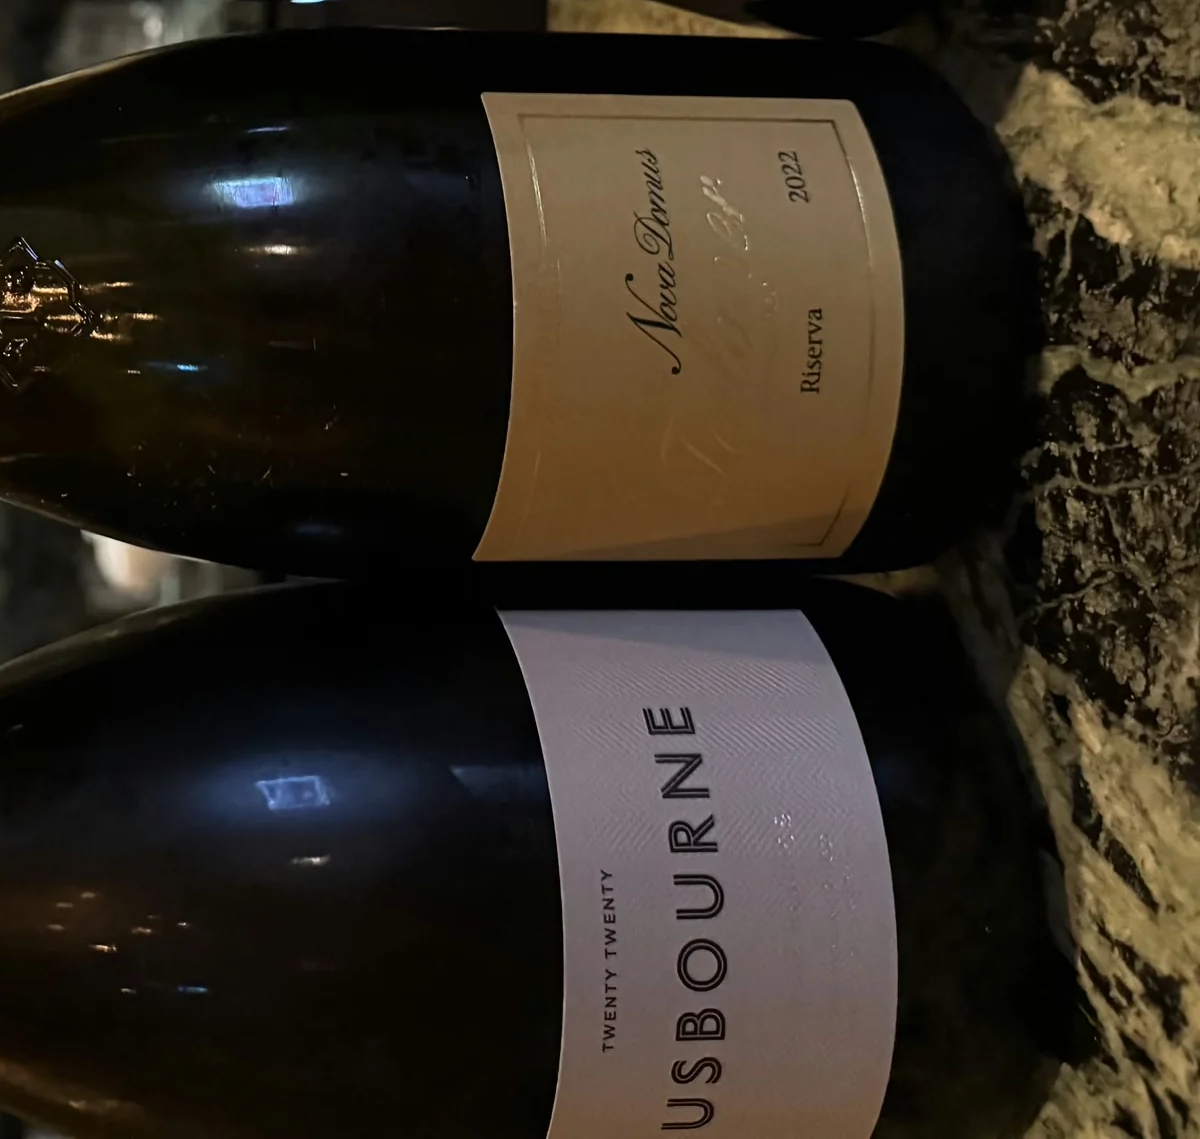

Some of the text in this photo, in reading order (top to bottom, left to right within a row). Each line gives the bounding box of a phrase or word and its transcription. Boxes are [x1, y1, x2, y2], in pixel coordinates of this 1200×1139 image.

[624, 147, 683, 375] Nova Domus
[777, 150, 811, 203] 2022
[800, 308, 824, 394] Riserva
[600, 868, 618, 1052] TWENTY TWENTY
[642, 706, 728, 1131] USBOURNE
